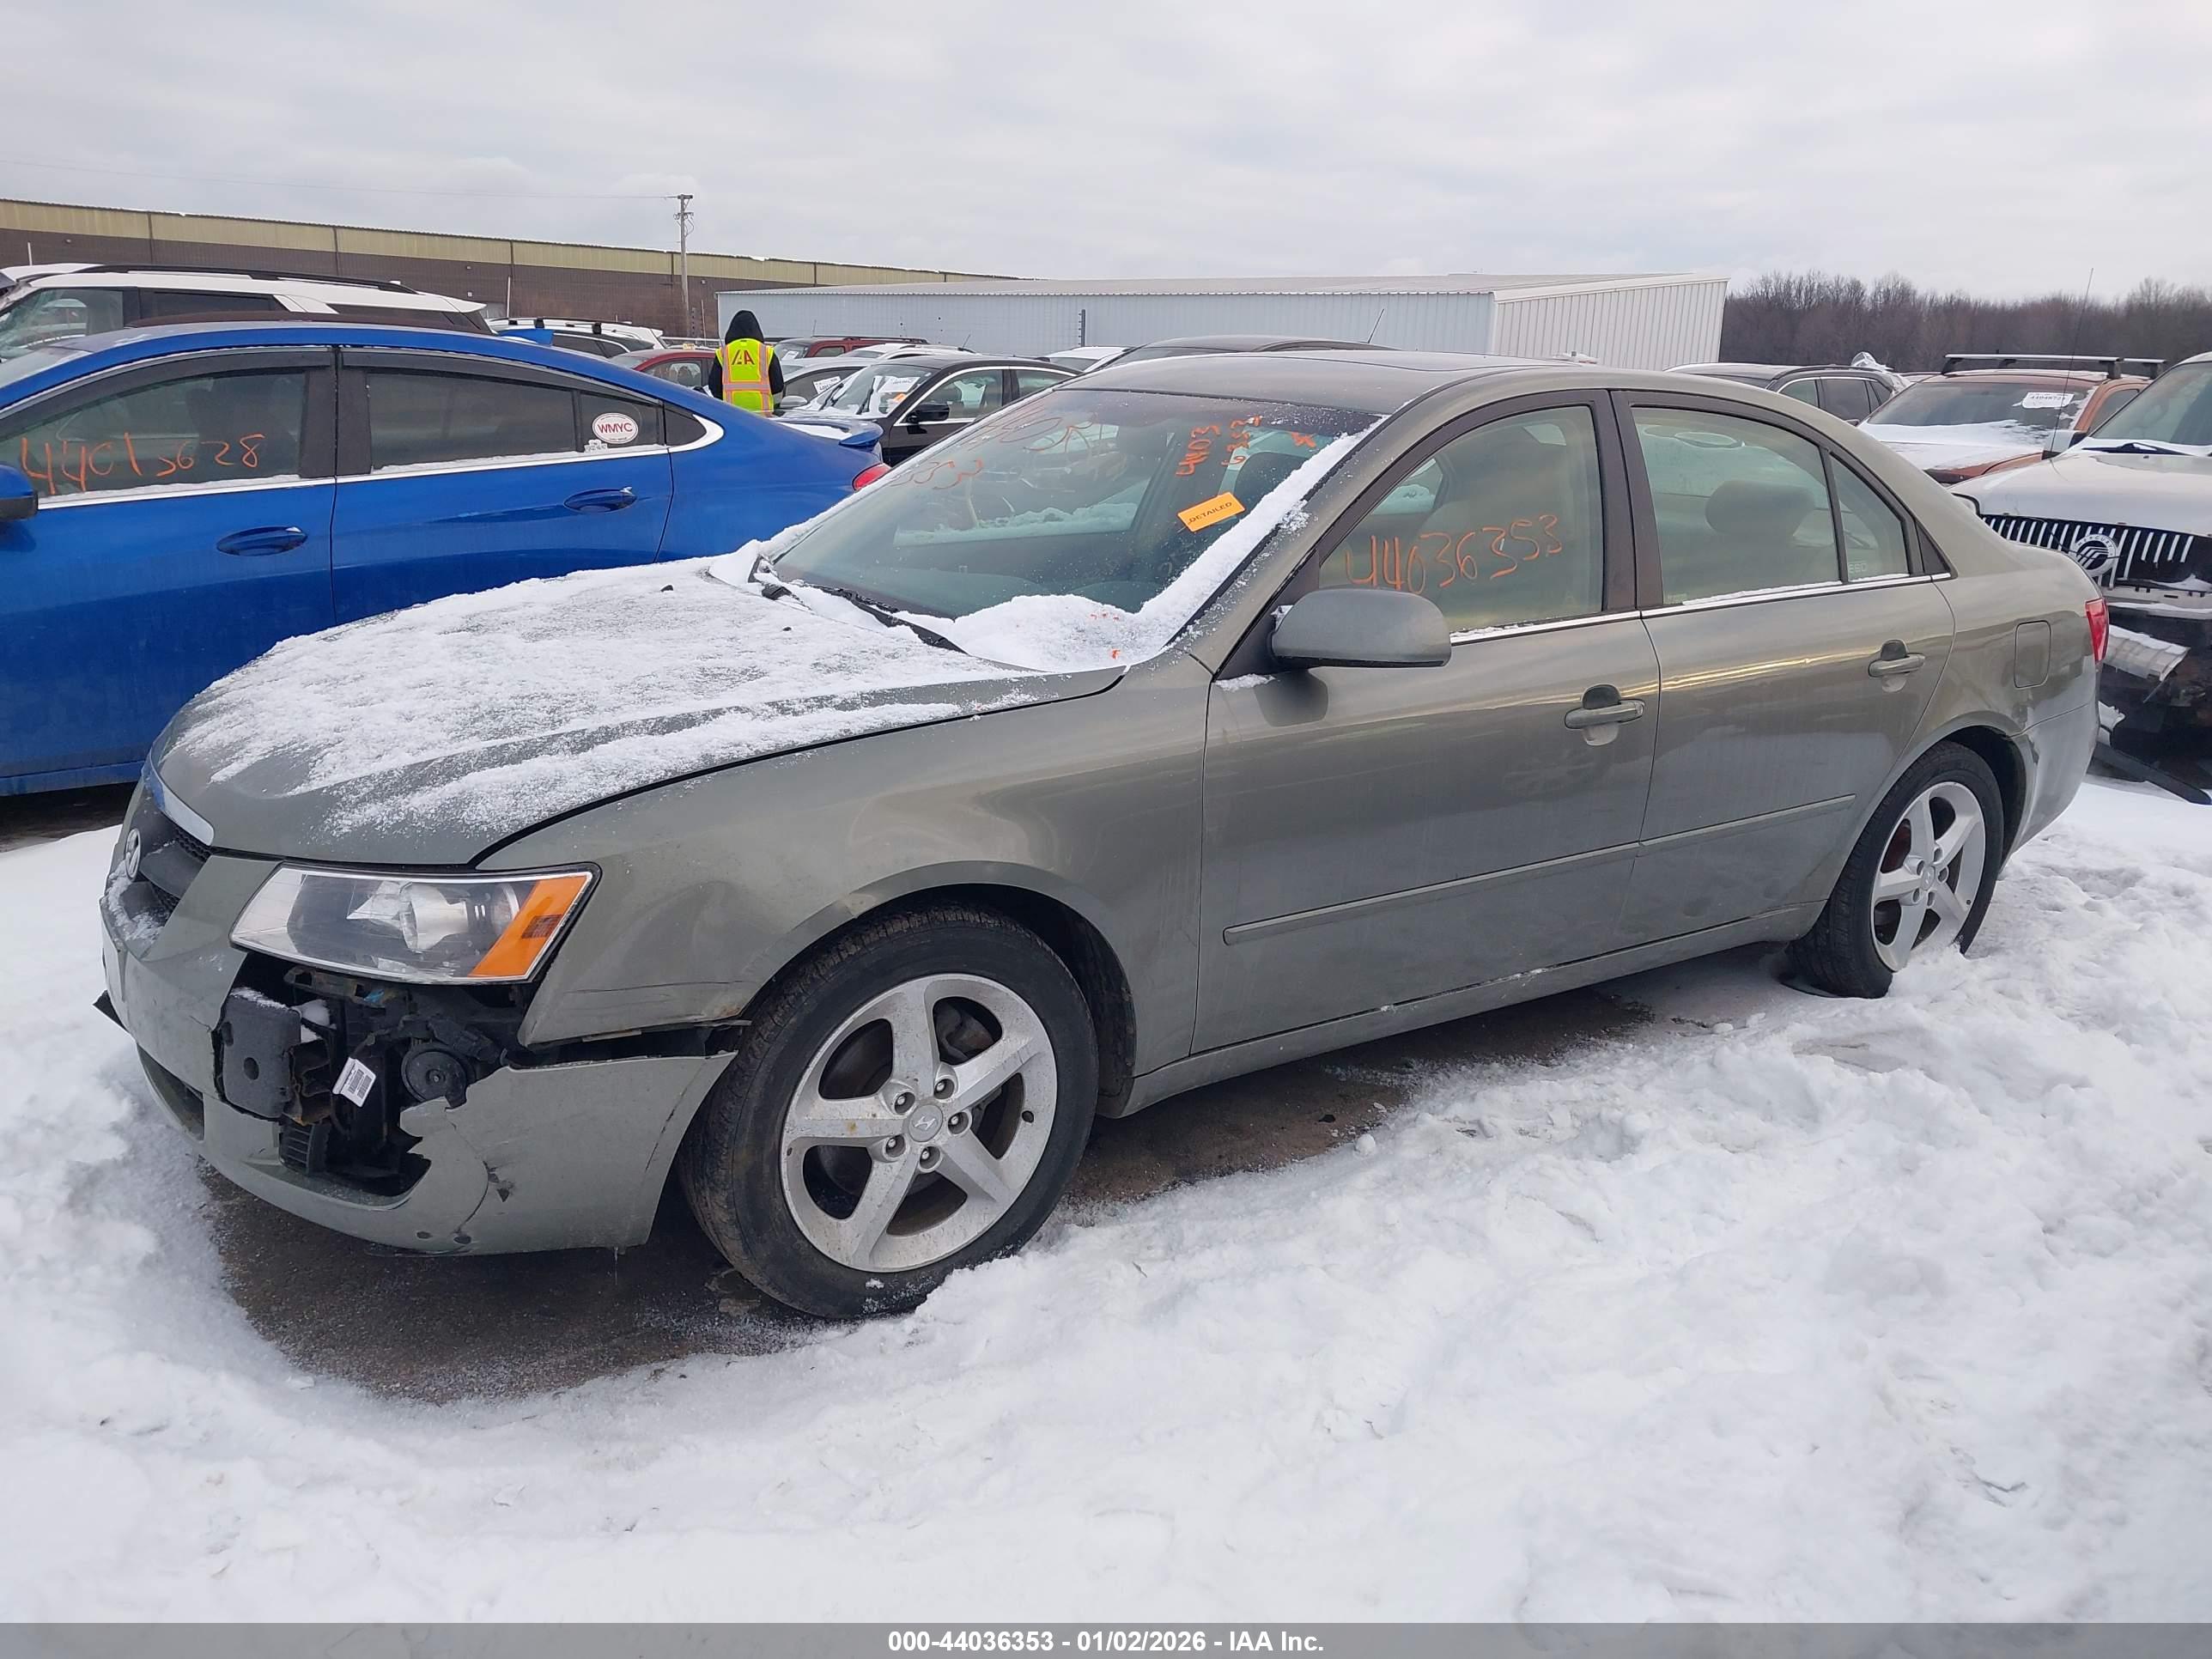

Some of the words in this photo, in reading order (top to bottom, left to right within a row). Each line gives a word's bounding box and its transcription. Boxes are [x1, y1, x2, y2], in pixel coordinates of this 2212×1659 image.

[597, 422, 634, 434] WMYC
[1188, 501, 1233, 524] DETAILED
[1345, 514, 1563, 594] 44036353
